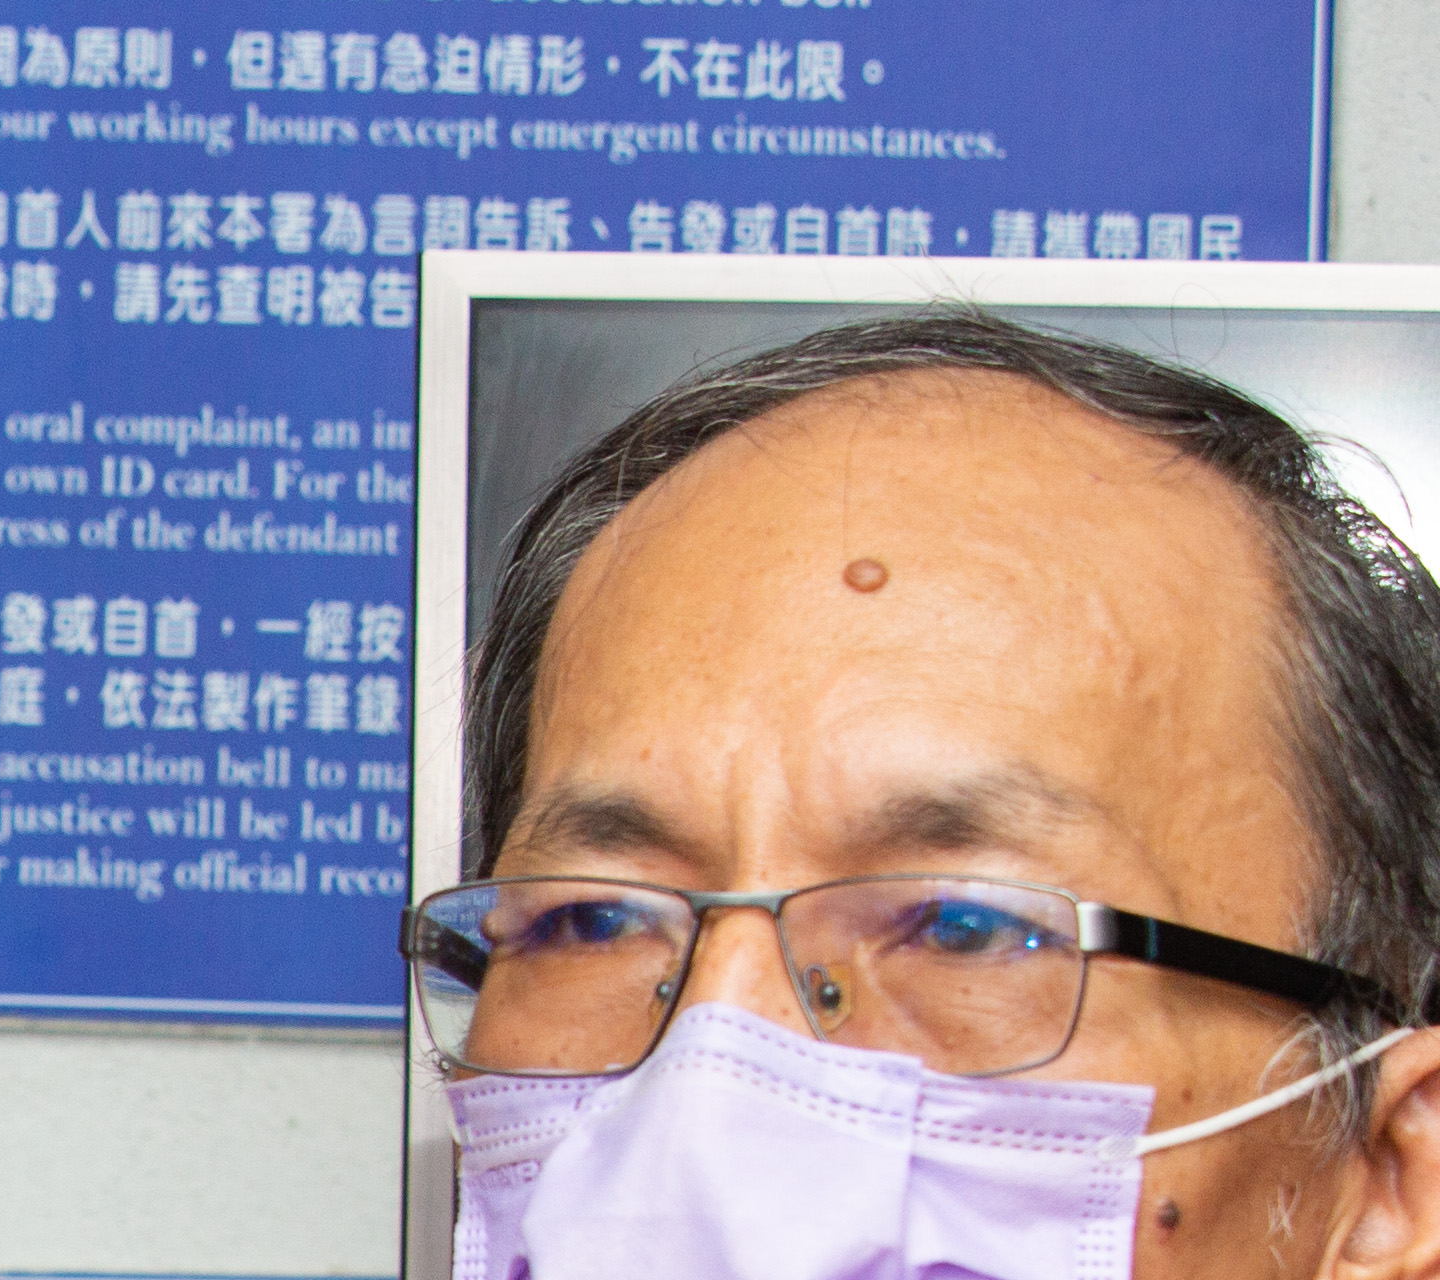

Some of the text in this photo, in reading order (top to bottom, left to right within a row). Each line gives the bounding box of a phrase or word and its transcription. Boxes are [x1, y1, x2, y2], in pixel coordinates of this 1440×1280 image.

[69, 100, 234, 158] working
[246, 101, 359, 146] hours
[369, 115, 499, 161] except
[510, 116, 700, 165] emergent
[711, 114, 1006, 161] circumstances.
[4, 401, 84, 443] oral
[311, 418, 361, 450] an
[3, 464, 88, 496] own
[101, 453, 156, 498] ID
[273, 457, 346, 501] For
[356, 460, 412, 504] the
[79, 506, 127, 551] of
[130, 507, 197, 552] the
[203, 509, 398, 556] defendant
[216, 744, 291, 789] bell
[303, 756, 347, 791] to
[146, 796, 226, 841] will
[238, 798, 288, 842] be
[298, 799, 363, 844] led
[18, 845, 166, 903] making
[172, 850, 308, 895] official
